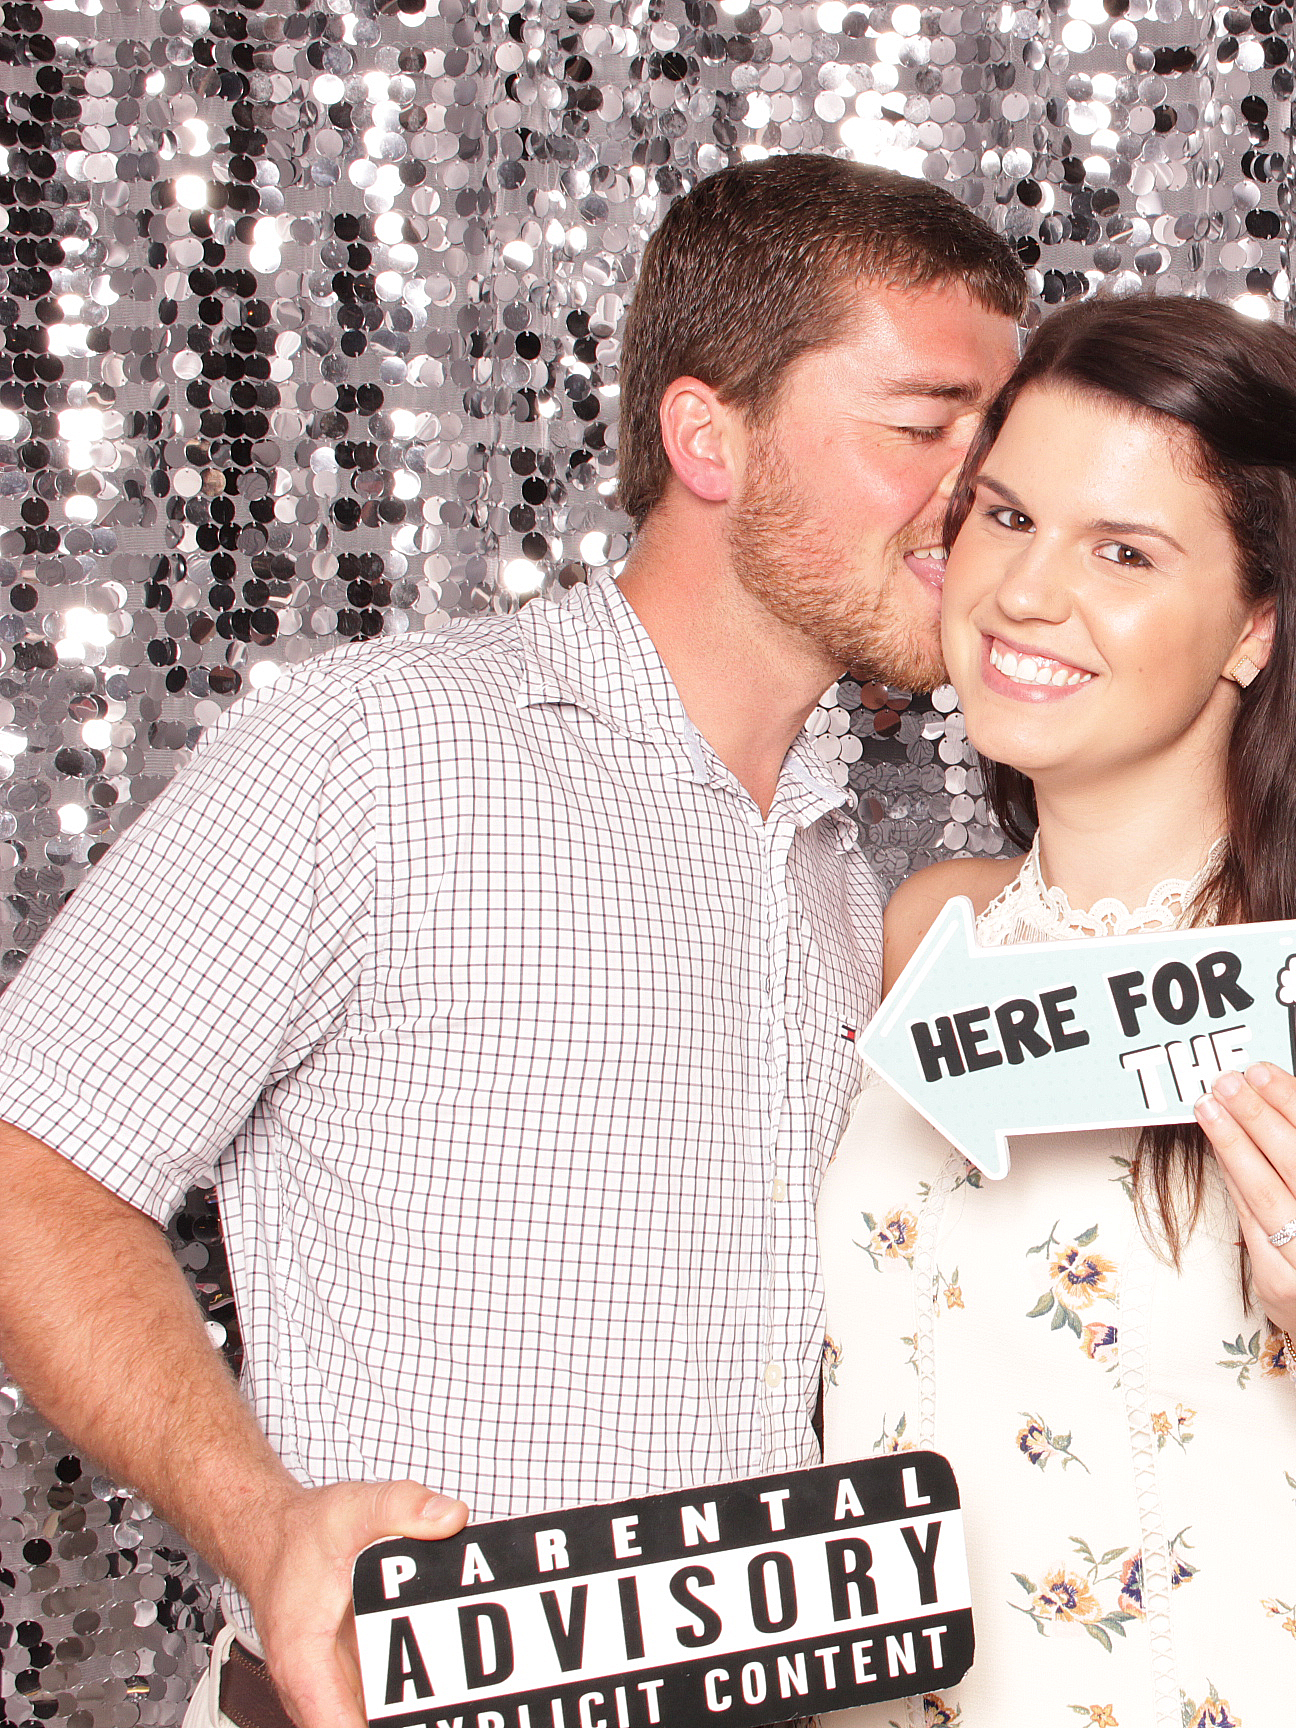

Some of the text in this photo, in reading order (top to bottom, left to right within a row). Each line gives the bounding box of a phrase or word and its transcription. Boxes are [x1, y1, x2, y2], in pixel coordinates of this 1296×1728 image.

[910, 950, 1255, 1083] HERE FOR
[1119, 1024, 1253, 1114] THE
[380, 1466, 932, 1600] PARENTAL
[383, 1520, 944, 1706] ADVISORY
[400, 1625, 950, 1728] ICIT CONTENT
